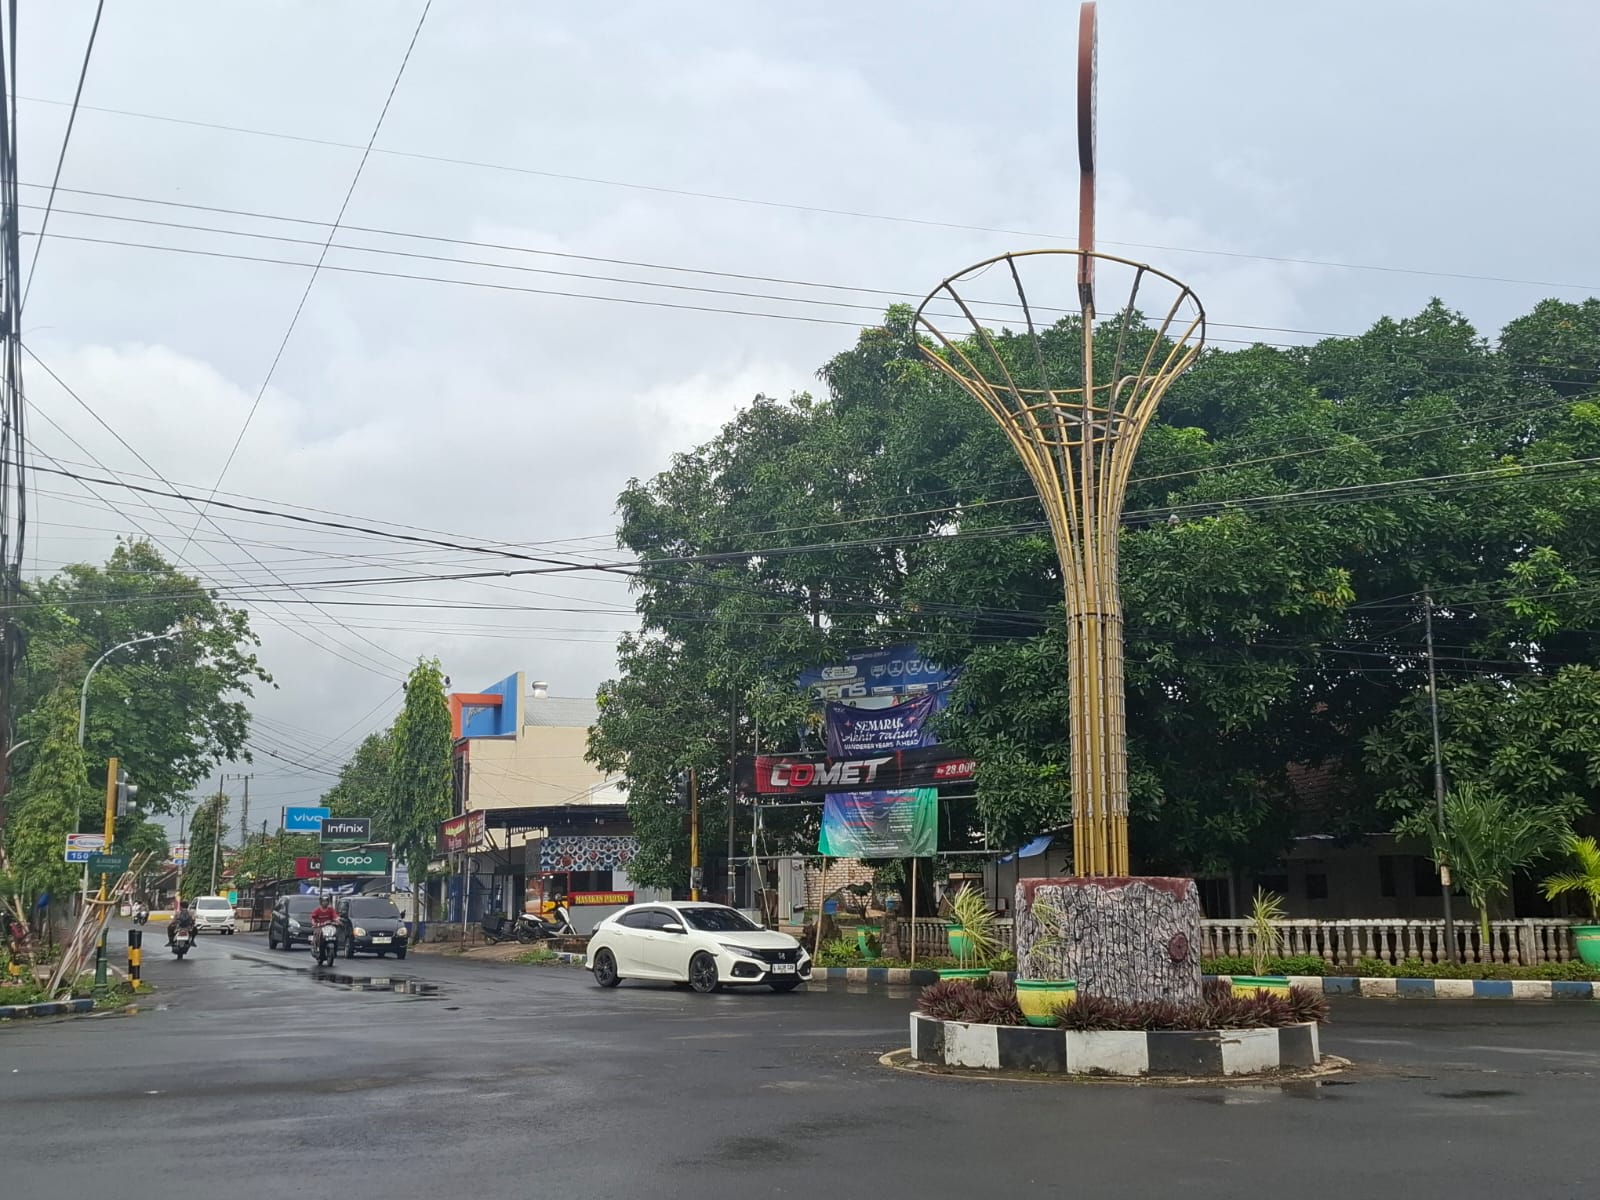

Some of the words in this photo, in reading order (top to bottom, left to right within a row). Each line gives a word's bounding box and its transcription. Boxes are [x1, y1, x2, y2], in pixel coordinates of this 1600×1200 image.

[854, 717, 904, 731] SEMARAK
[841, 731, 876, 742] Akhir
[879, 728, 919, 741] Tahun
[770, 757, 893, 787] COMET
[294, 813, 323, 822] vivo
[327, 823, 364, 834] Infinix
[337, 856, 372, 866] oppo
